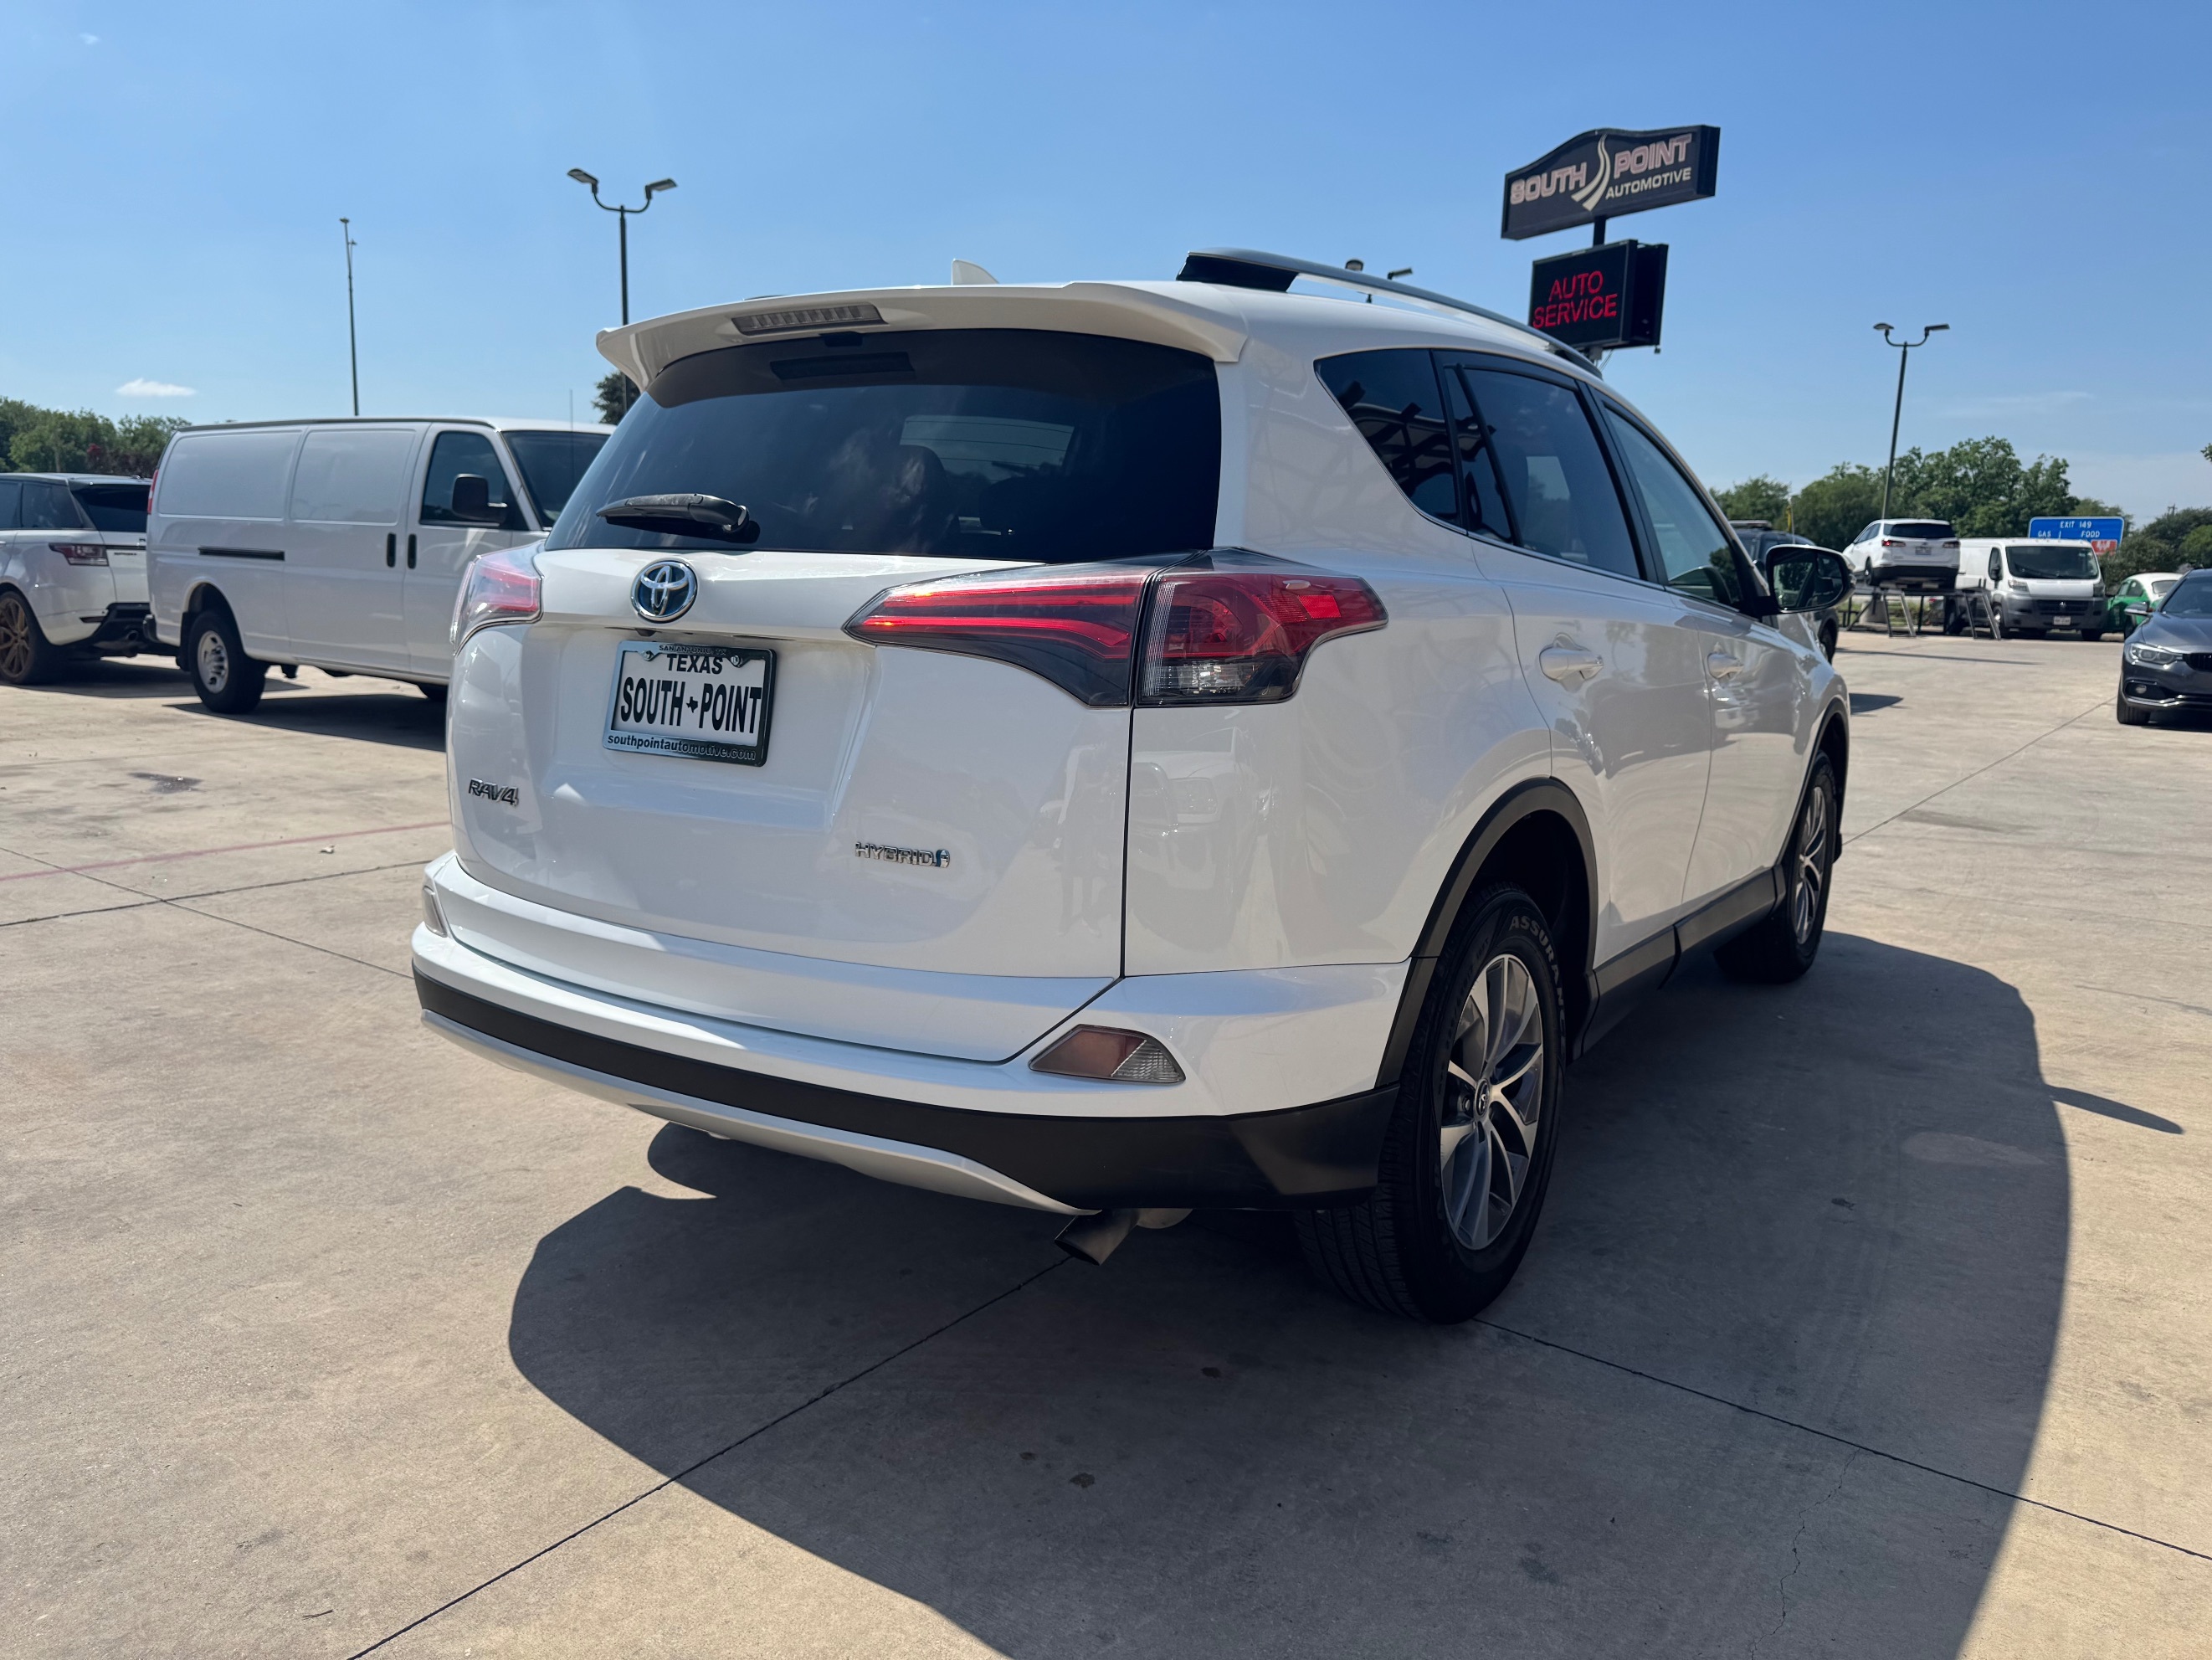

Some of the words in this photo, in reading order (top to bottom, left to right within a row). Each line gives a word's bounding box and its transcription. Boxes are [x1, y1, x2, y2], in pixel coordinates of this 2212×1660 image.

[1510, 162, 1588, 204] SOUTH
[1614, 134, 1691, 179] POINT
[1605, 167, 1691, 200] AUTOMOTIVE
[1548, 270, 1604, 301] AUTO
[1532, 294, 1618, 329] SERVICE
[667, 654, 723, 675] TEXAS
[620, 676, 685, 727] SOUTH
[699, 683, 762, 734] POINT
[608, 735, 756, 760] southpointautomotive.com
[469, 778, 519, 807] RAV4
[855, 842, 935, 866] HYBRID
